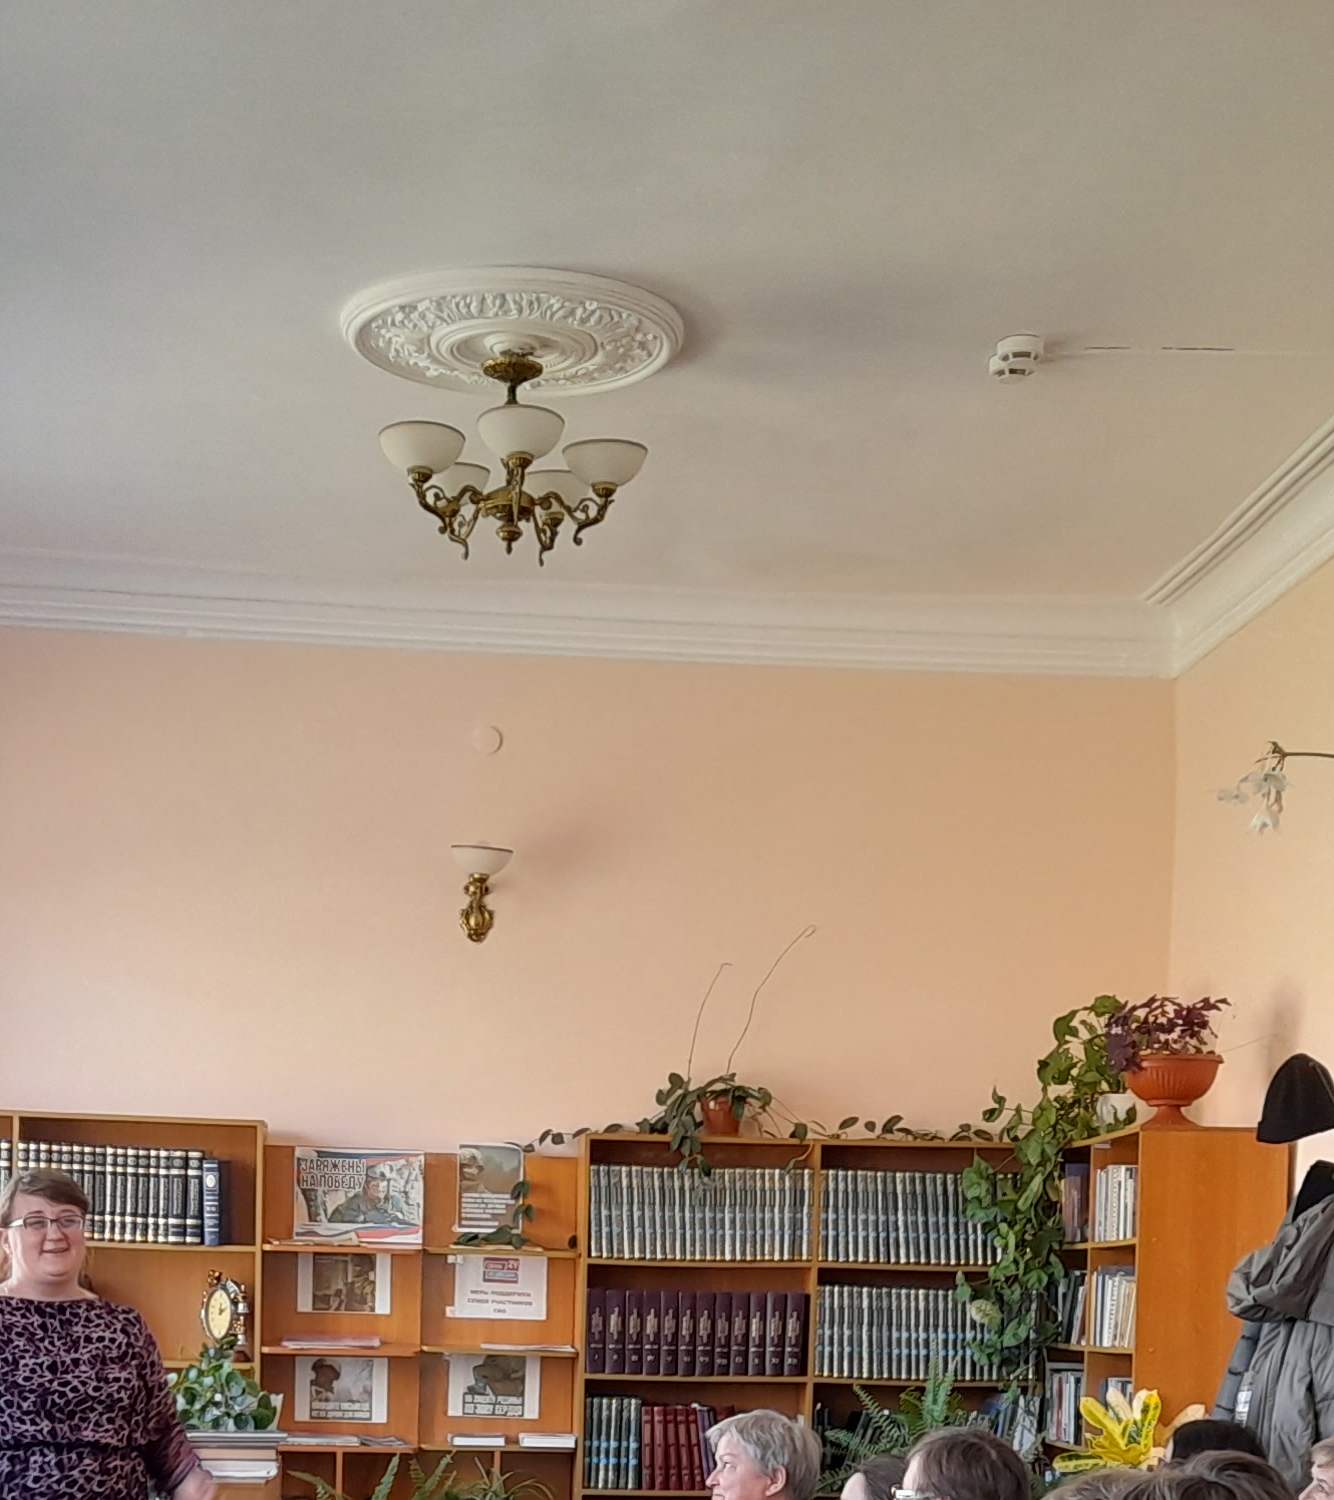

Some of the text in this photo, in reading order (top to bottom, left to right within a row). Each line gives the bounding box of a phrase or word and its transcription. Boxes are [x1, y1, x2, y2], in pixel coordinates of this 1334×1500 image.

[300, 1159, 366, 1174] ЗАРЯЖЕНЫ
[301, 1174, 365, 1189] НА ПОБЕДУ
